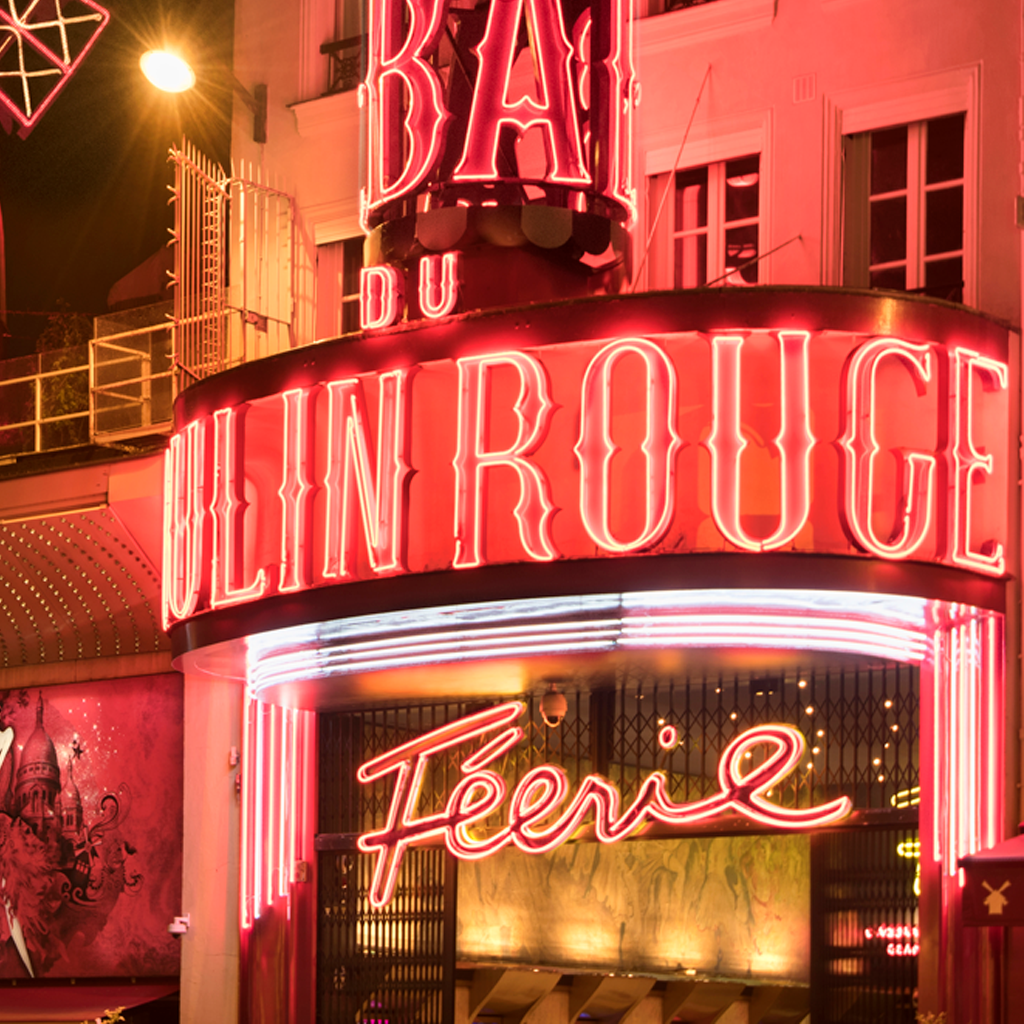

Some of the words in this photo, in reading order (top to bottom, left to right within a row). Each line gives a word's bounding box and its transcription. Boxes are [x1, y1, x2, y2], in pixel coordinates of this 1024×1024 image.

[359, 252, 459, 330] DU
[162, 368, 408, 631] ULIN
[451, 330, 1009, 577] ROUGE
[356, 700, 853, 908] Féerie
